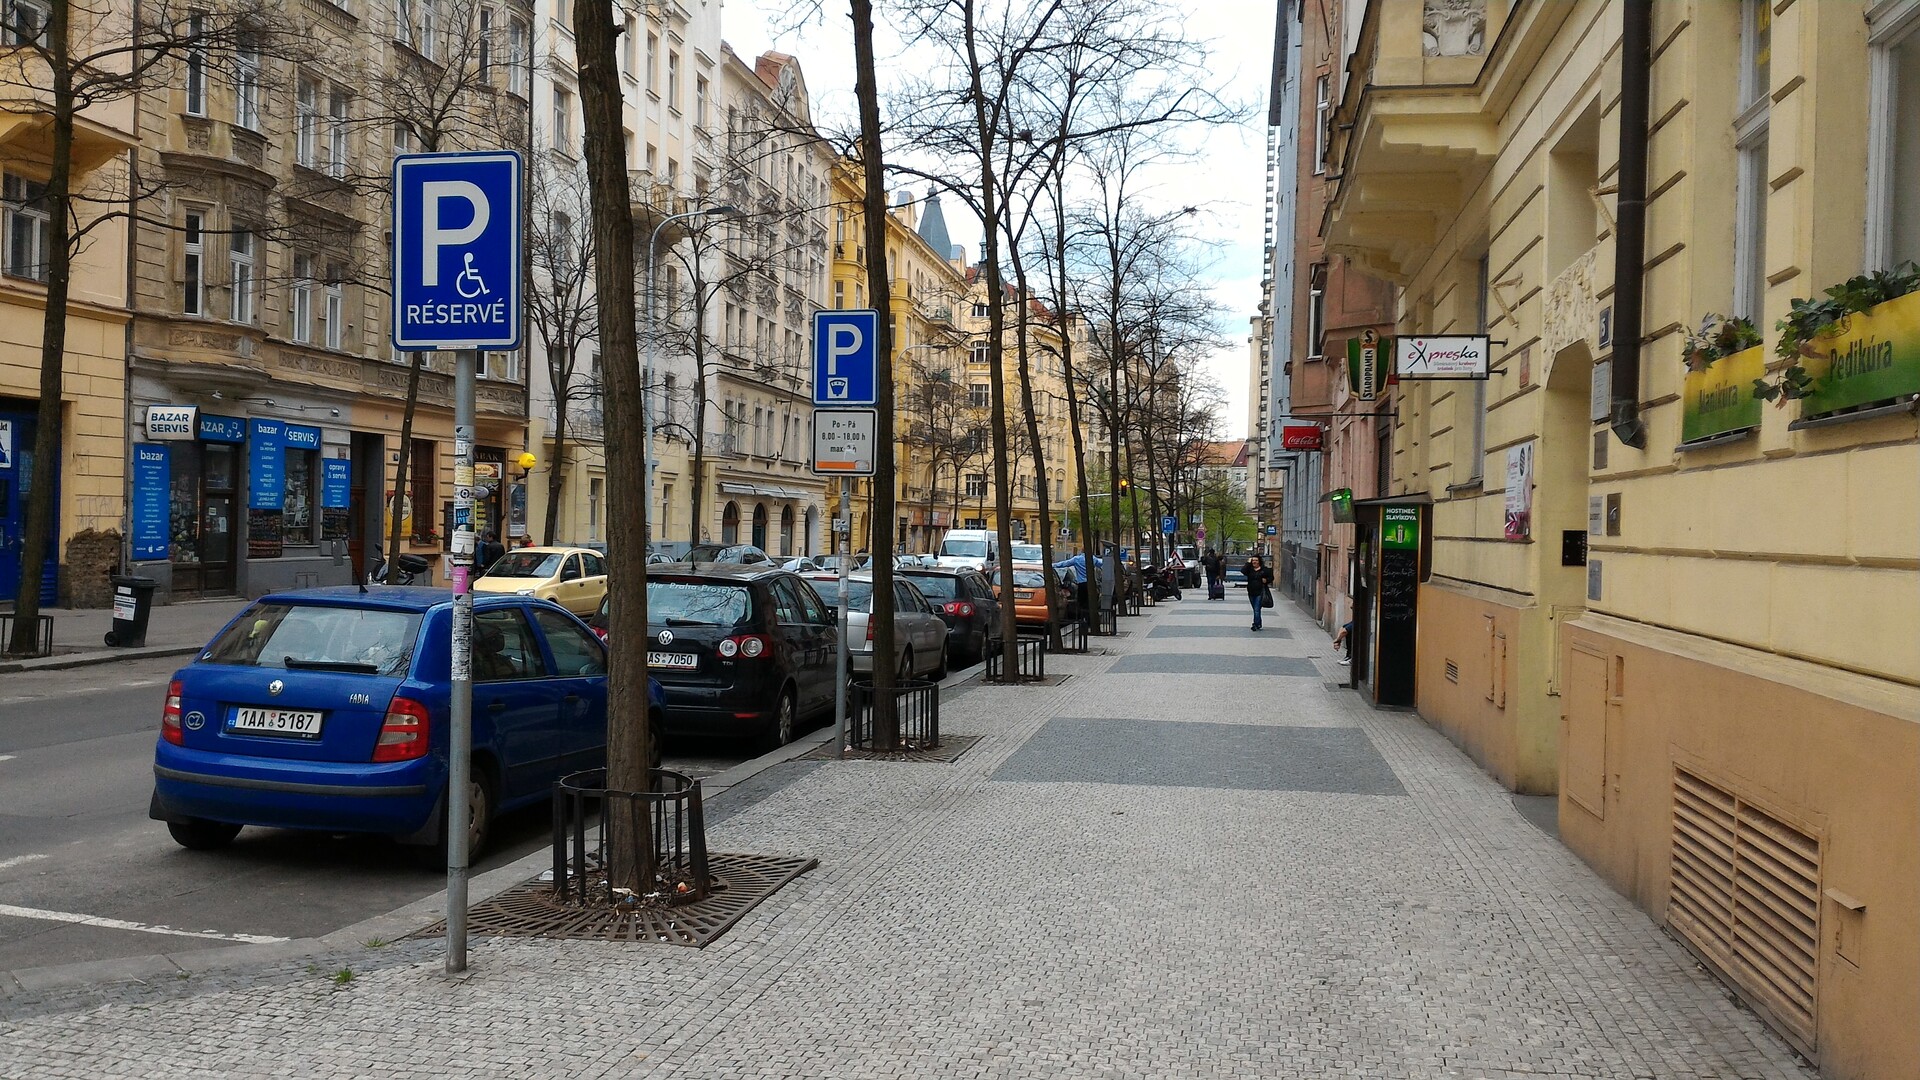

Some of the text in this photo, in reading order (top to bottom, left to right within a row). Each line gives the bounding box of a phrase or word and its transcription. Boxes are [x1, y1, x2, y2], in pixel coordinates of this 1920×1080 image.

[422, 180, 490, 286] P
[407, 297, 504, 324] RÉSERVÉ
[827, 323, 863, 375] P
[1830, 335, 1892, 382] Pedikúra
[1363, 349, 1373, 398] STAROPRAMEN
[151, 413, 189, 422] BAZAR
[151, 423, 189, 433] SERVIS
[200, 421, 224, 433] AZAR
[258, 423, 278, 434] bazar
[832, 420, 840, 428] Po
[848, 420, 856, 428] Pá
[288, 431, 314, 442] SERVIS
[821, 432, 835, 440] 8.00
[843, 432, 860, 441] 18.00
[1287, 435, 1314, 445] Coca-Cola
[140, 450, 164, 461] bazar
[474, 452, 498, 461] ABAK
[328, 464, 346, 472] opravy
[332, 472, 347, 480] servis
[1164, 519, 1171, 528] P
[669, 582, 697, 590] Praha
[668, 654, 693, 665] 7050
[349, 693, 369, 704] FABIA
[187, 716, 201, 727] CZ
[241, 710, 314, 731] 1AA 5187
